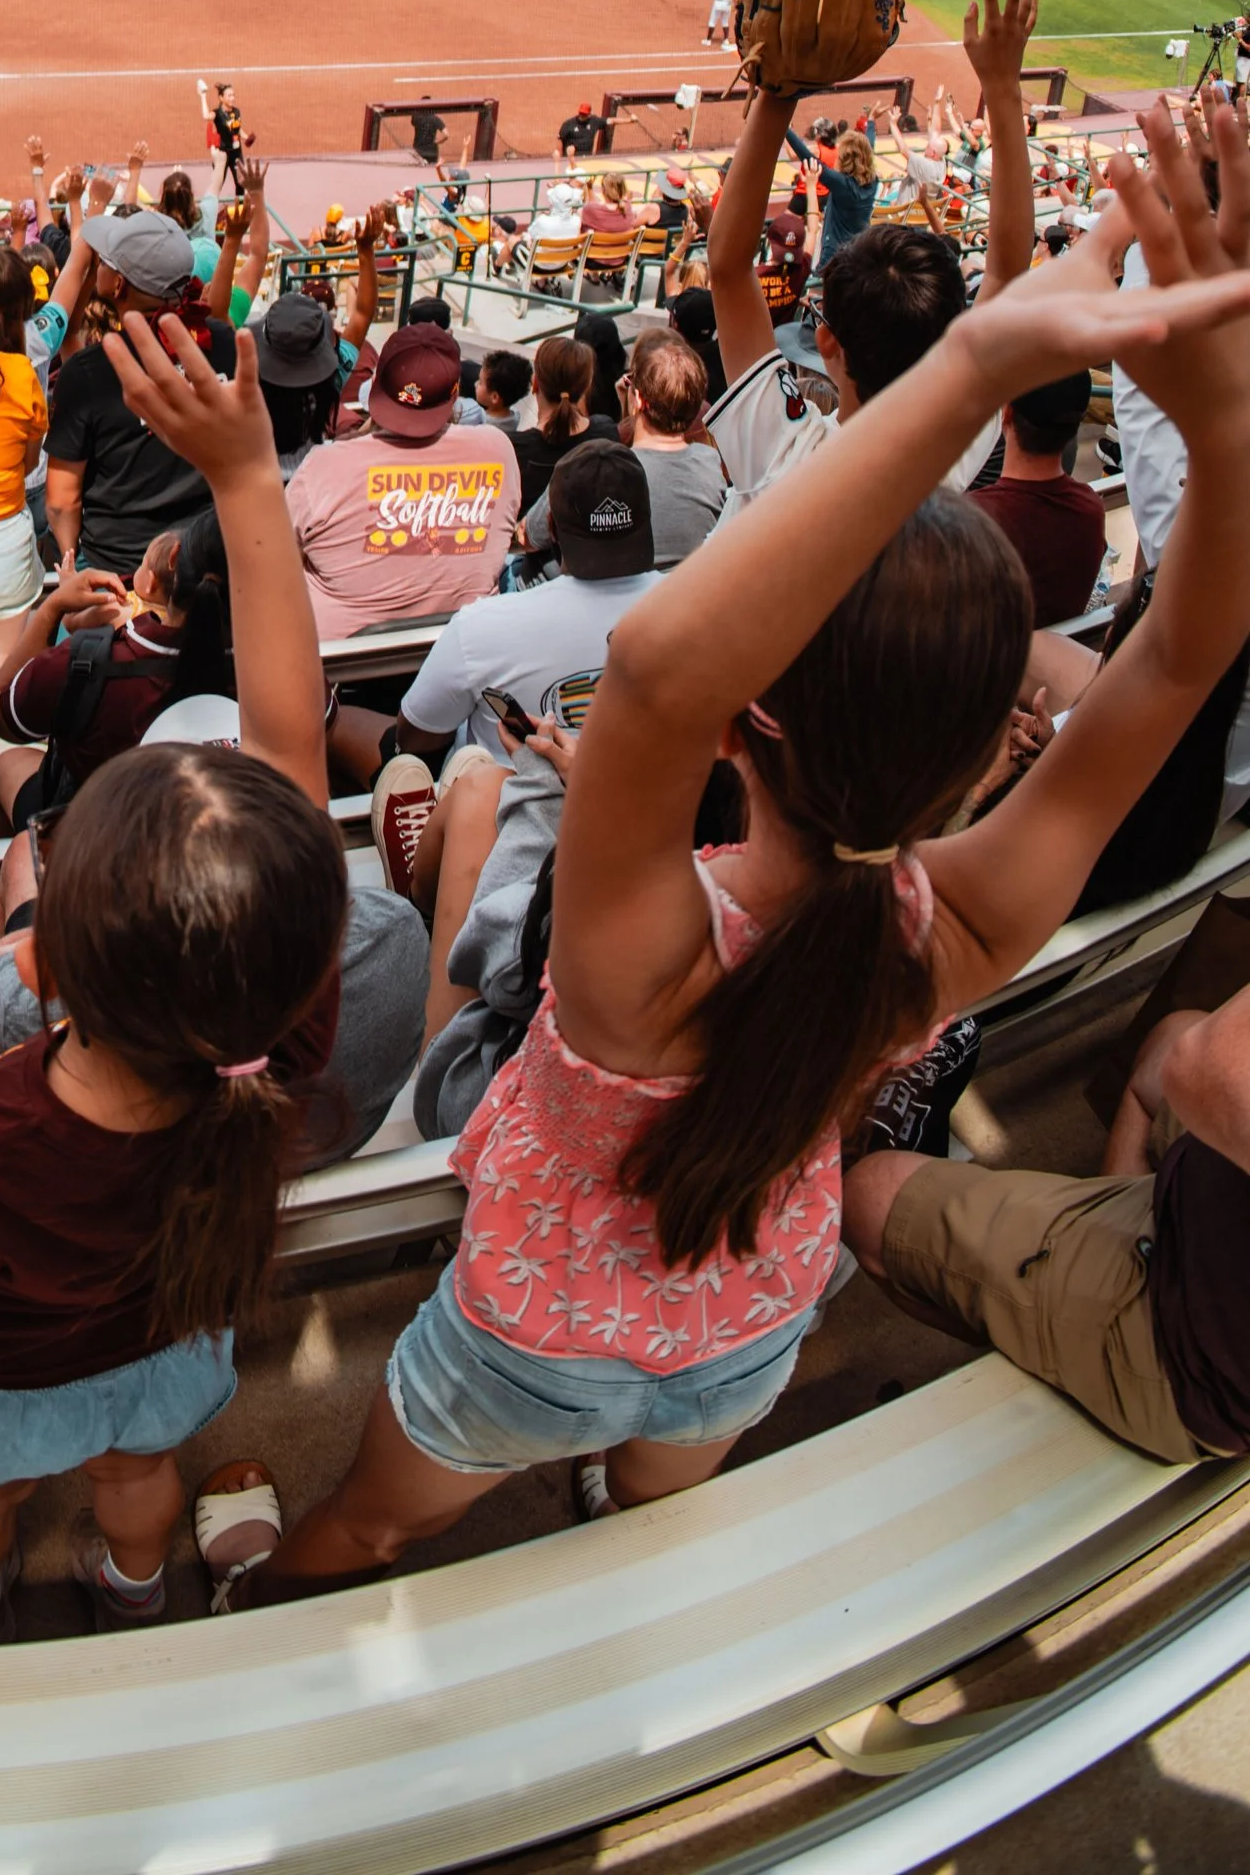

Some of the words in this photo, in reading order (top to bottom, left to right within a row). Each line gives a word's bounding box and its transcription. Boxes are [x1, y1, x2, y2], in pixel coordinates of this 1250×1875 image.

[460, 252, 471, 266] C
[372, 472, 423, 493] SUN
[428, 469, 502, 492] DEVILS
[376, 483, 494, 537] Softball
[590, 509, 633, 527] PINNACLE
